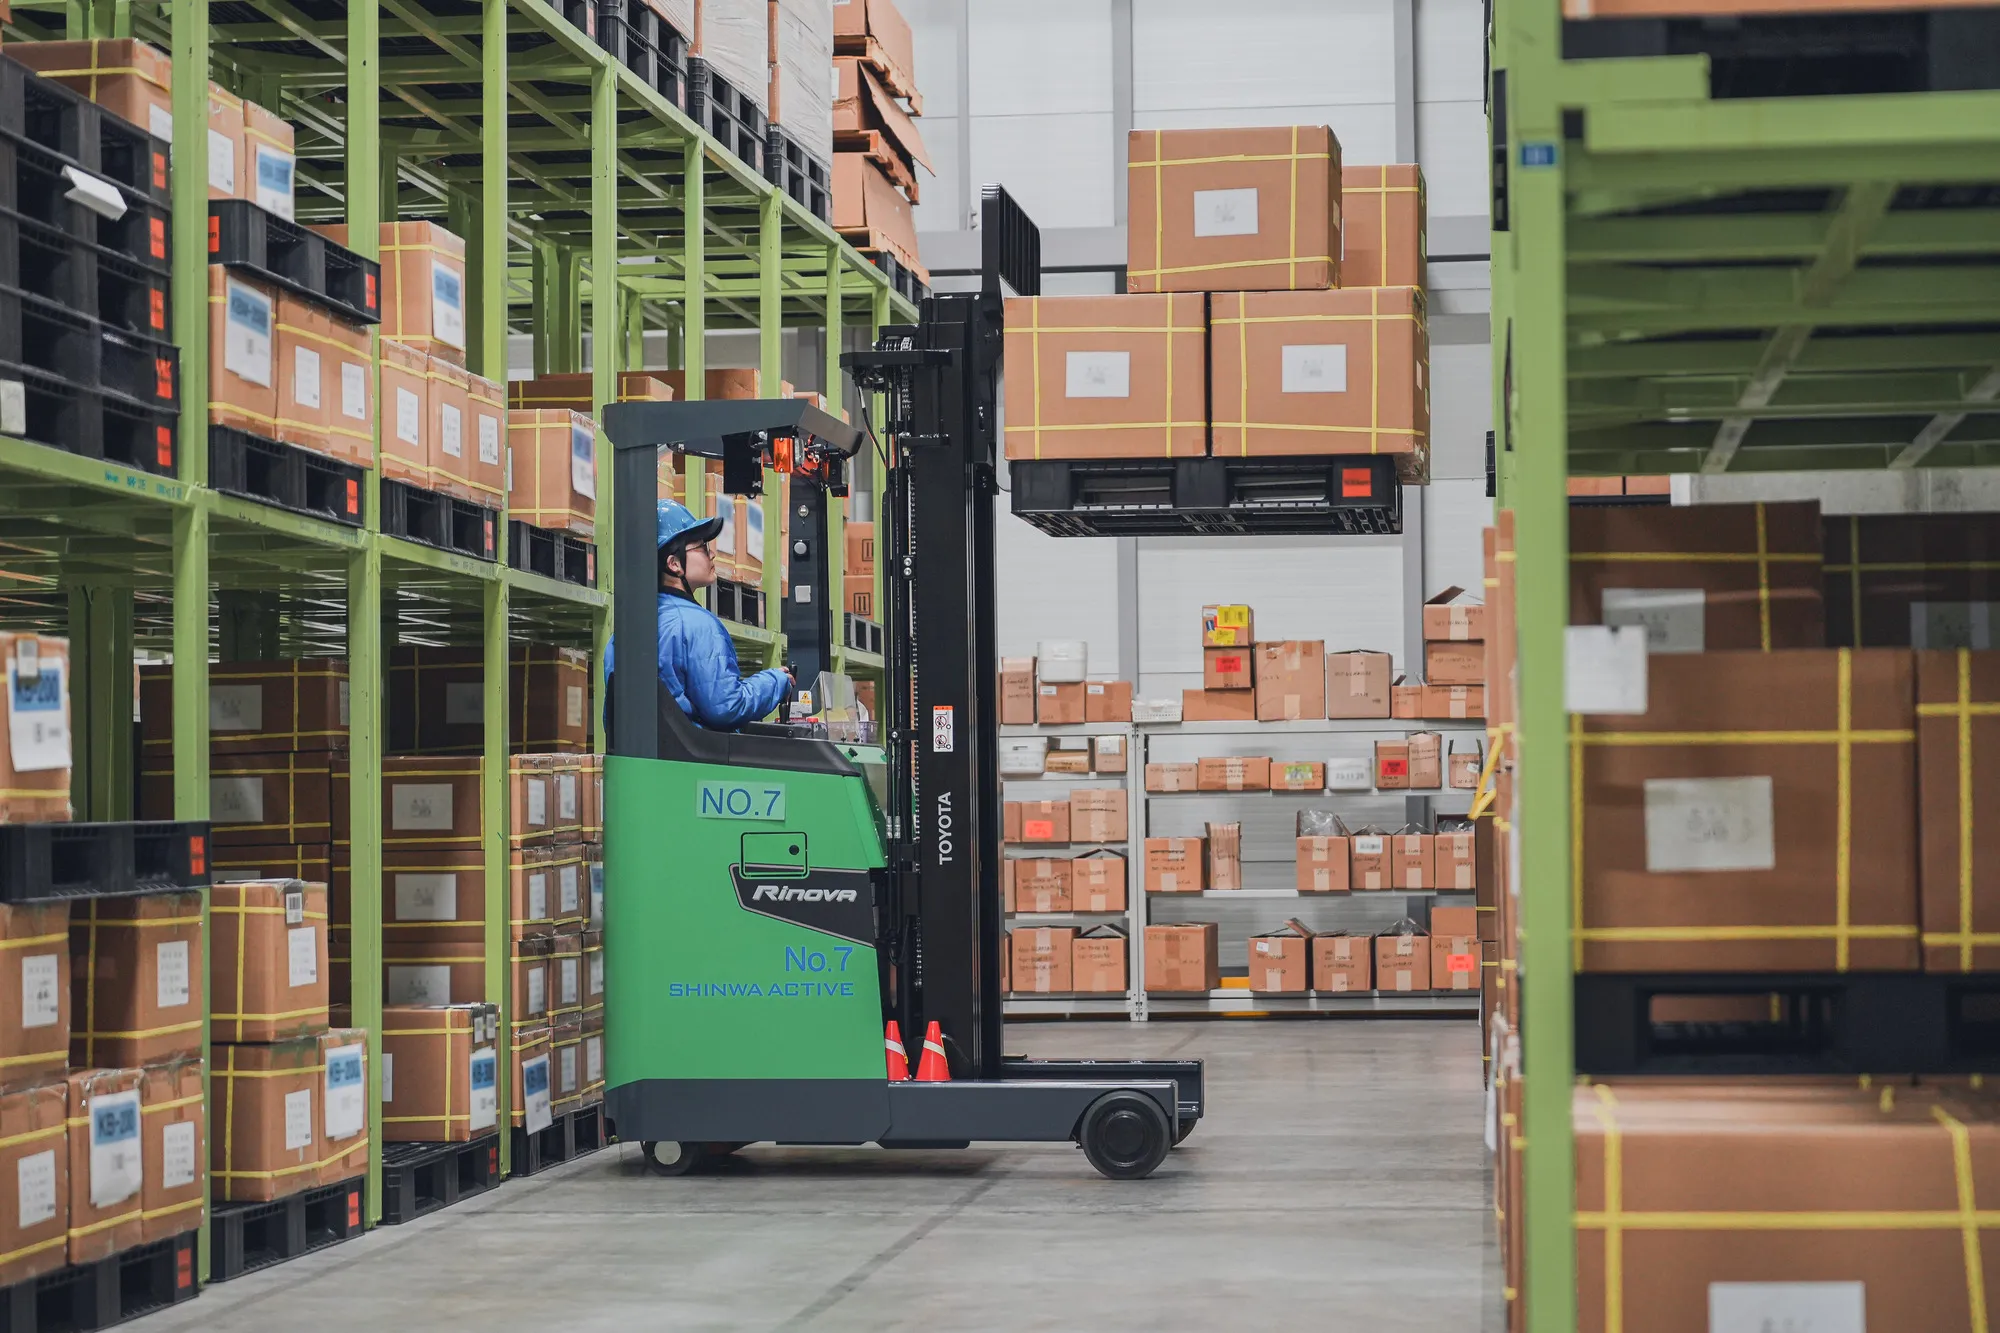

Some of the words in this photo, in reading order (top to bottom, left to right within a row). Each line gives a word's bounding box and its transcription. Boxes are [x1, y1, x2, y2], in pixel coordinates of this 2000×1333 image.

[702, 787, 781, 816] NO.7
[937, 791, 952, 865] TOYOTA
[752, 885, 857, 902] Rinova
[785, 946, 853, 972] No.7
[669, 983, 763, 996] SHINWA
[767, 982, 854, 996] ACTIVE
